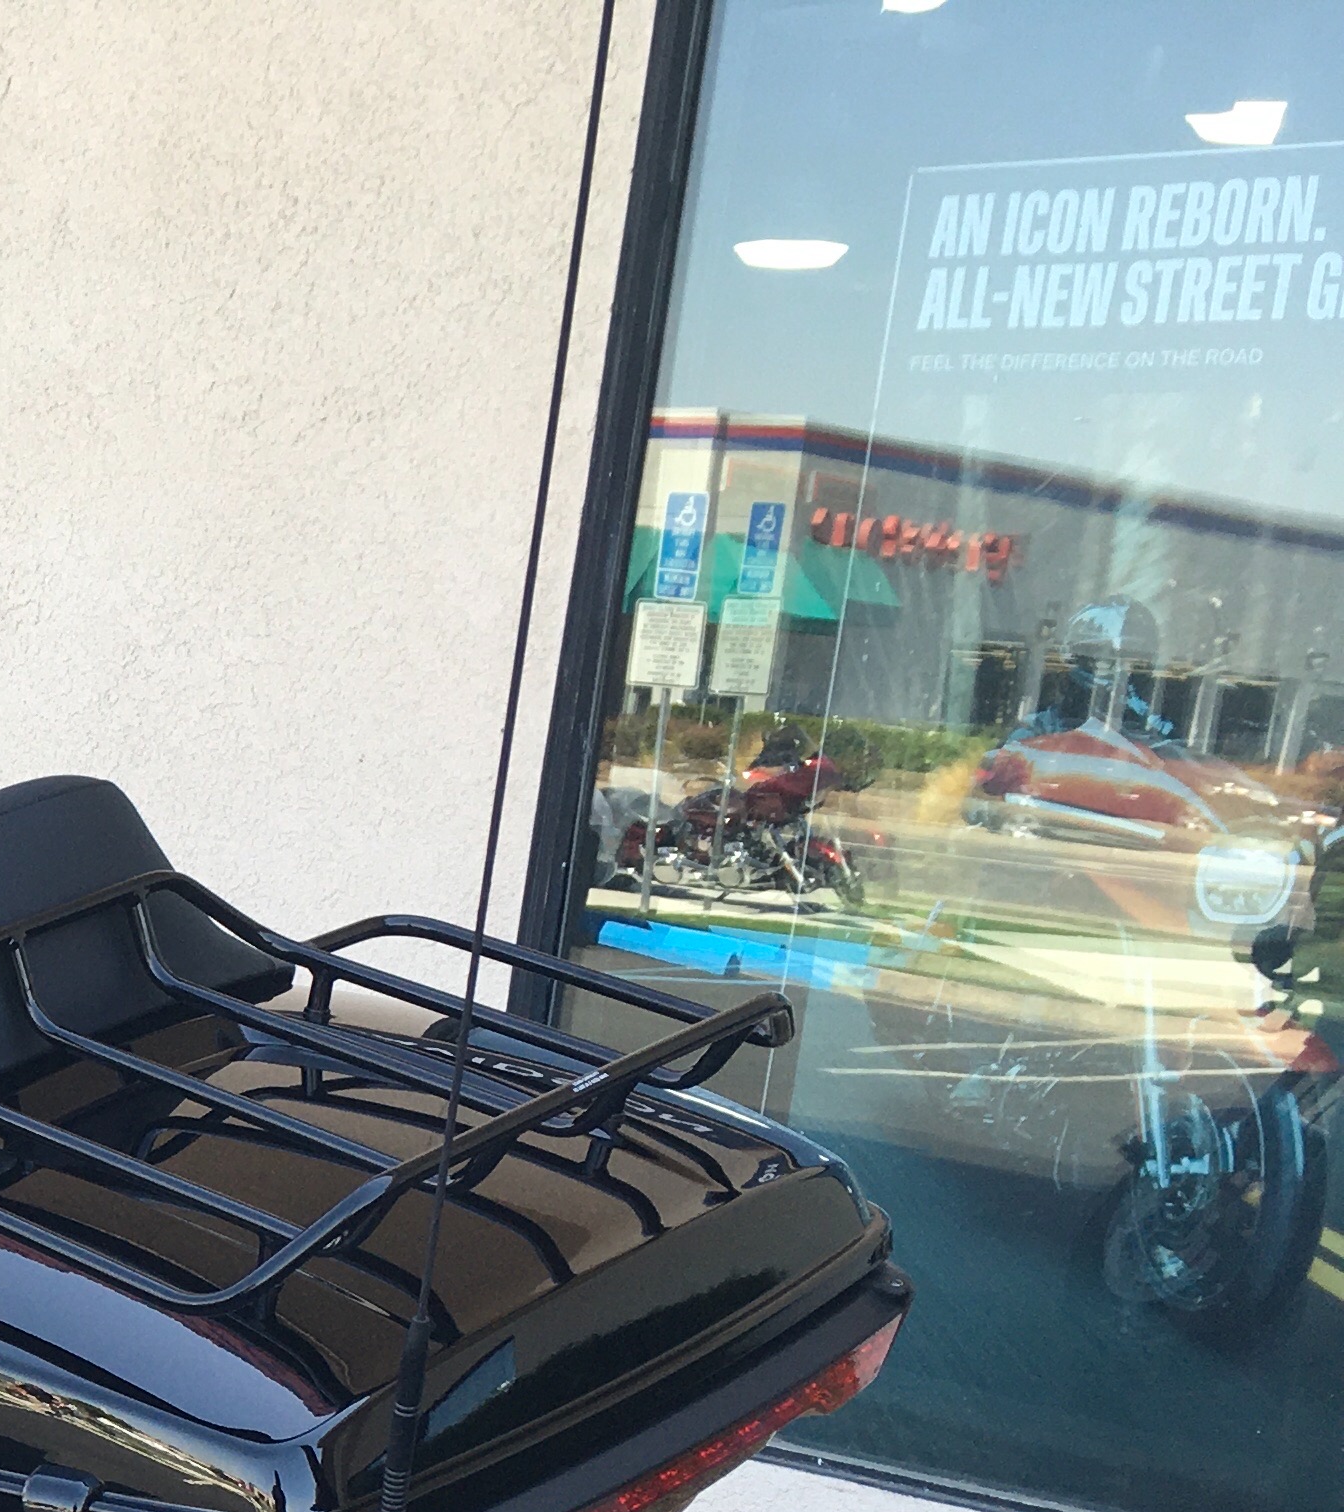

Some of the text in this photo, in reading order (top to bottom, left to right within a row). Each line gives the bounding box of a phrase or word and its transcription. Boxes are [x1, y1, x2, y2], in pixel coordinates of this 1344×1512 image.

[929, 175, 1326, 258] AN ICON REBORN.
[917, 252, 1344, 331] ALL-NEW STREET G
[909, 347, 1264, 371] FEEL THE DIFFERENCE ON THE ROAD
